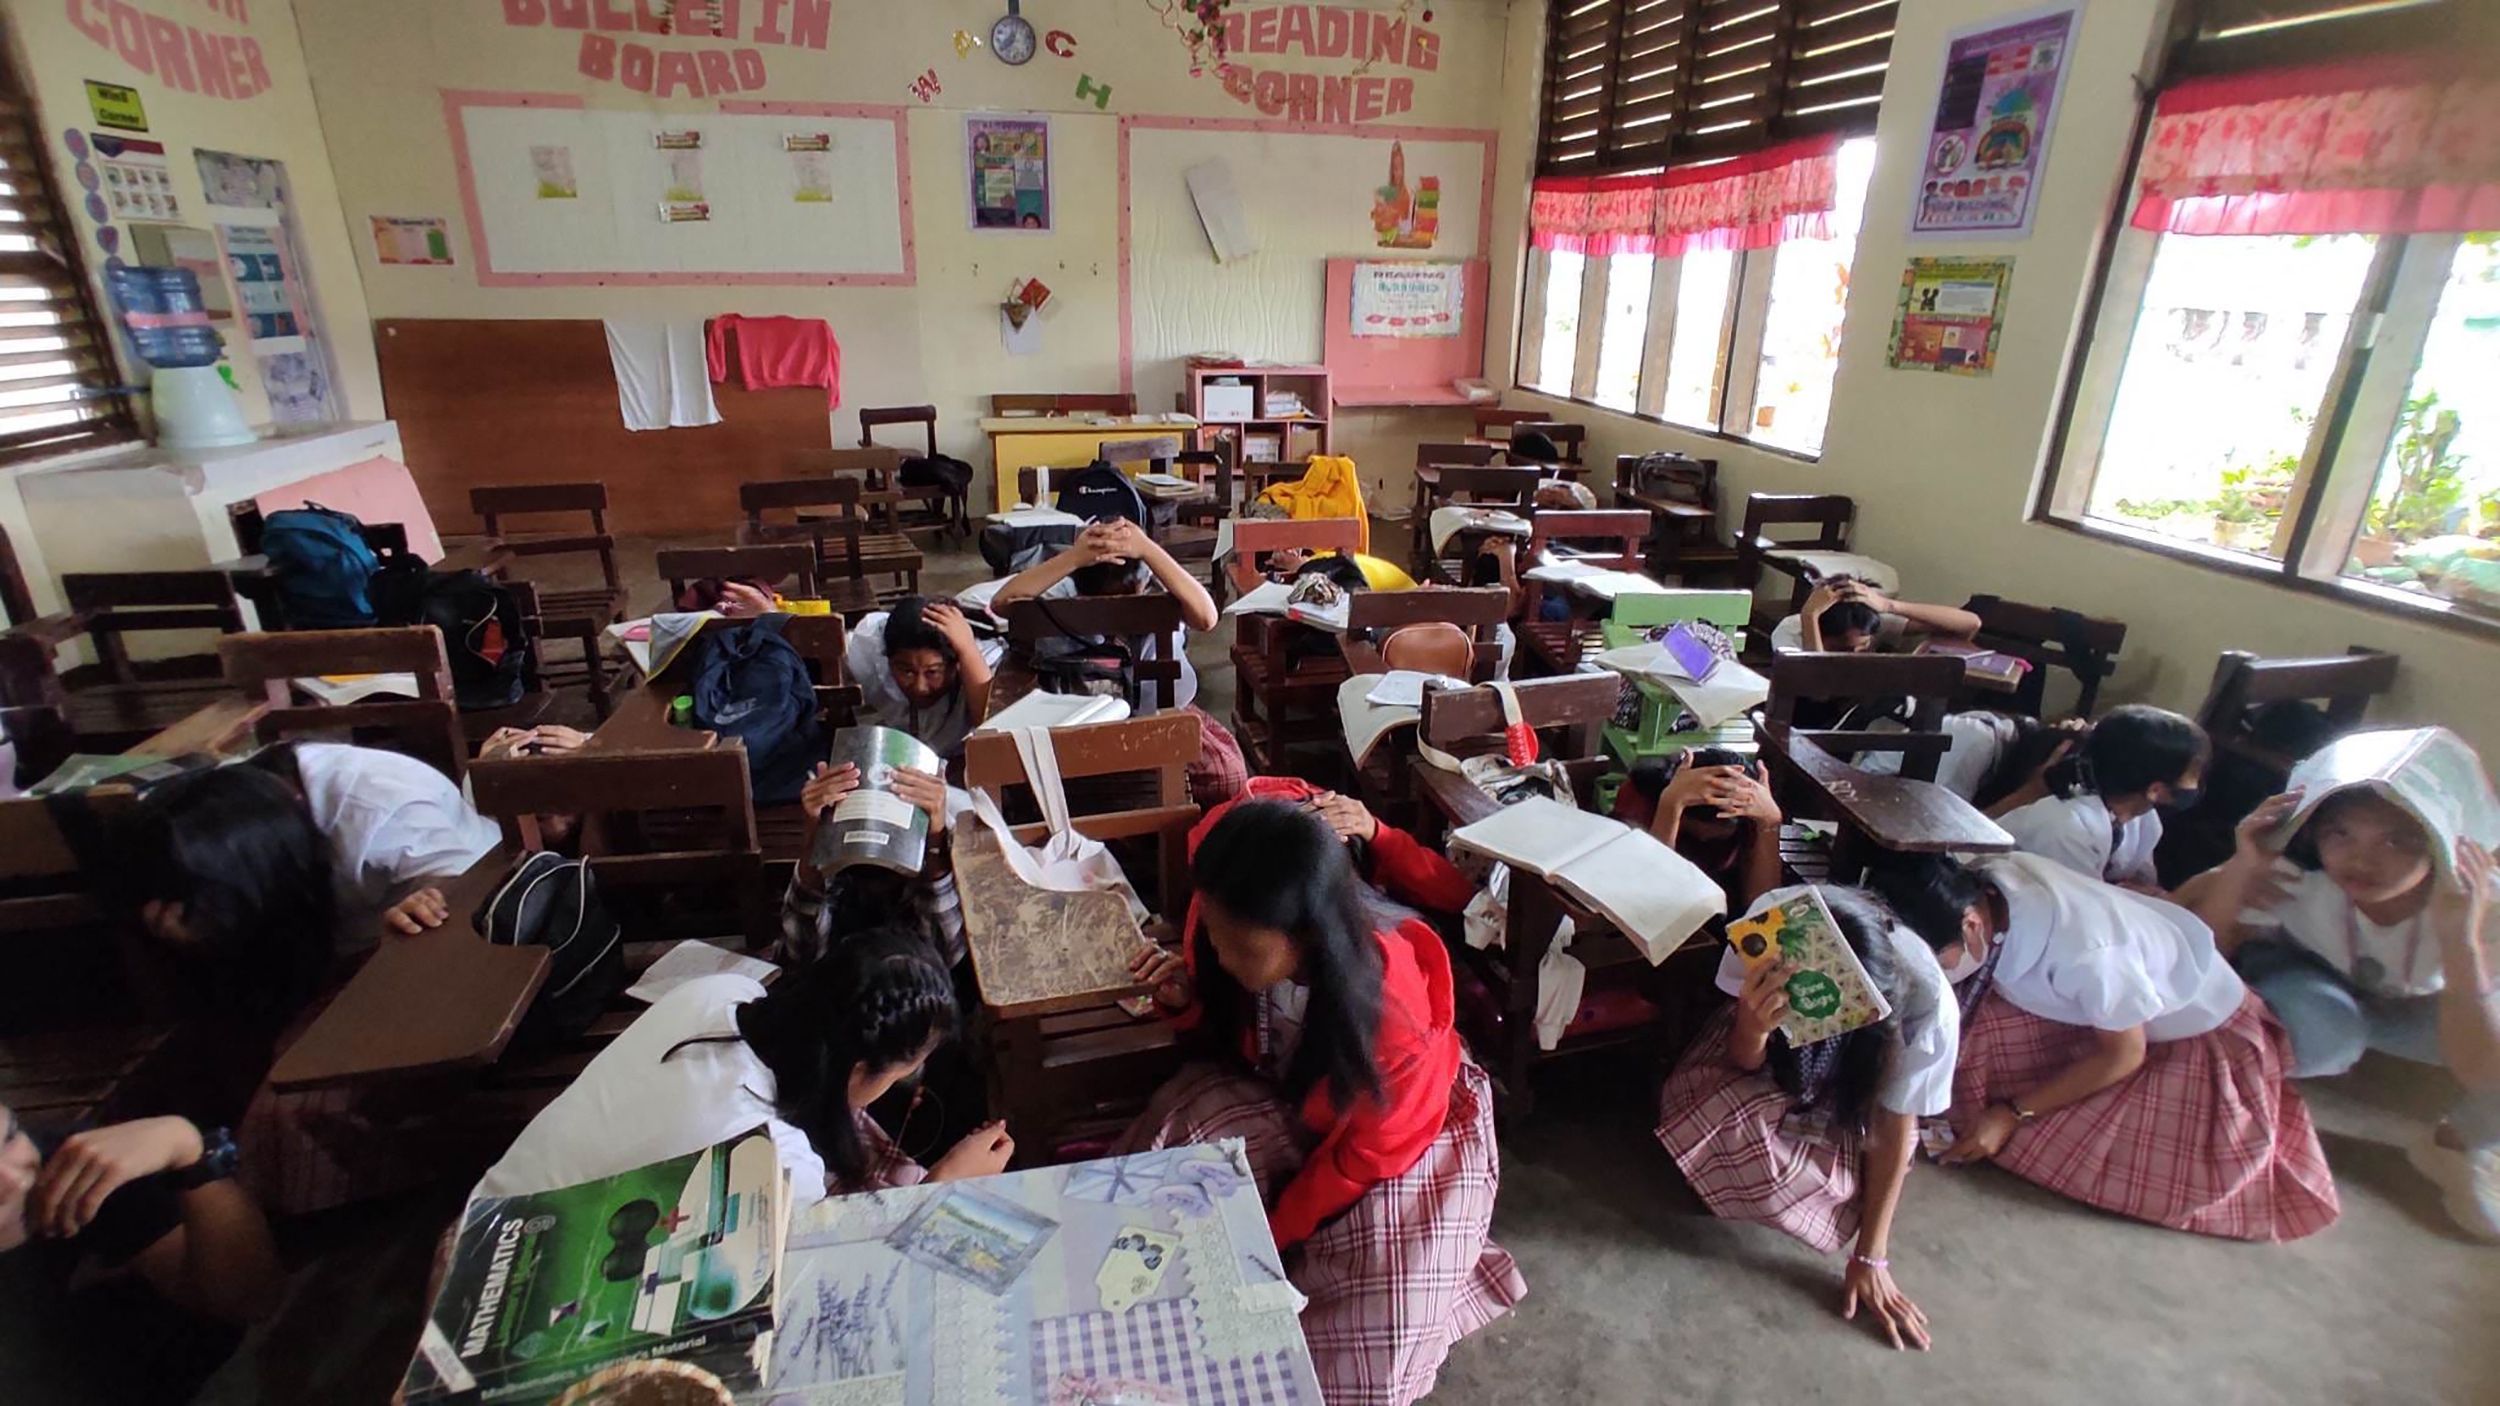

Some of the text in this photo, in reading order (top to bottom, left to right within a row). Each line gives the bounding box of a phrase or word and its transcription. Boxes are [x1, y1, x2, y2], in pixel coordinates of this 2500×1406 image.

[66, 0, 273, 100] CORNER
[578, 33, 767, 98] BOARD
[1216, 5, 1441, 71] READING
[1222, 64, 1415, 123] CORNER
[461, 1216, 525, 1358] MATHEMATICS
[651, 1334, 707, 1359] Material
